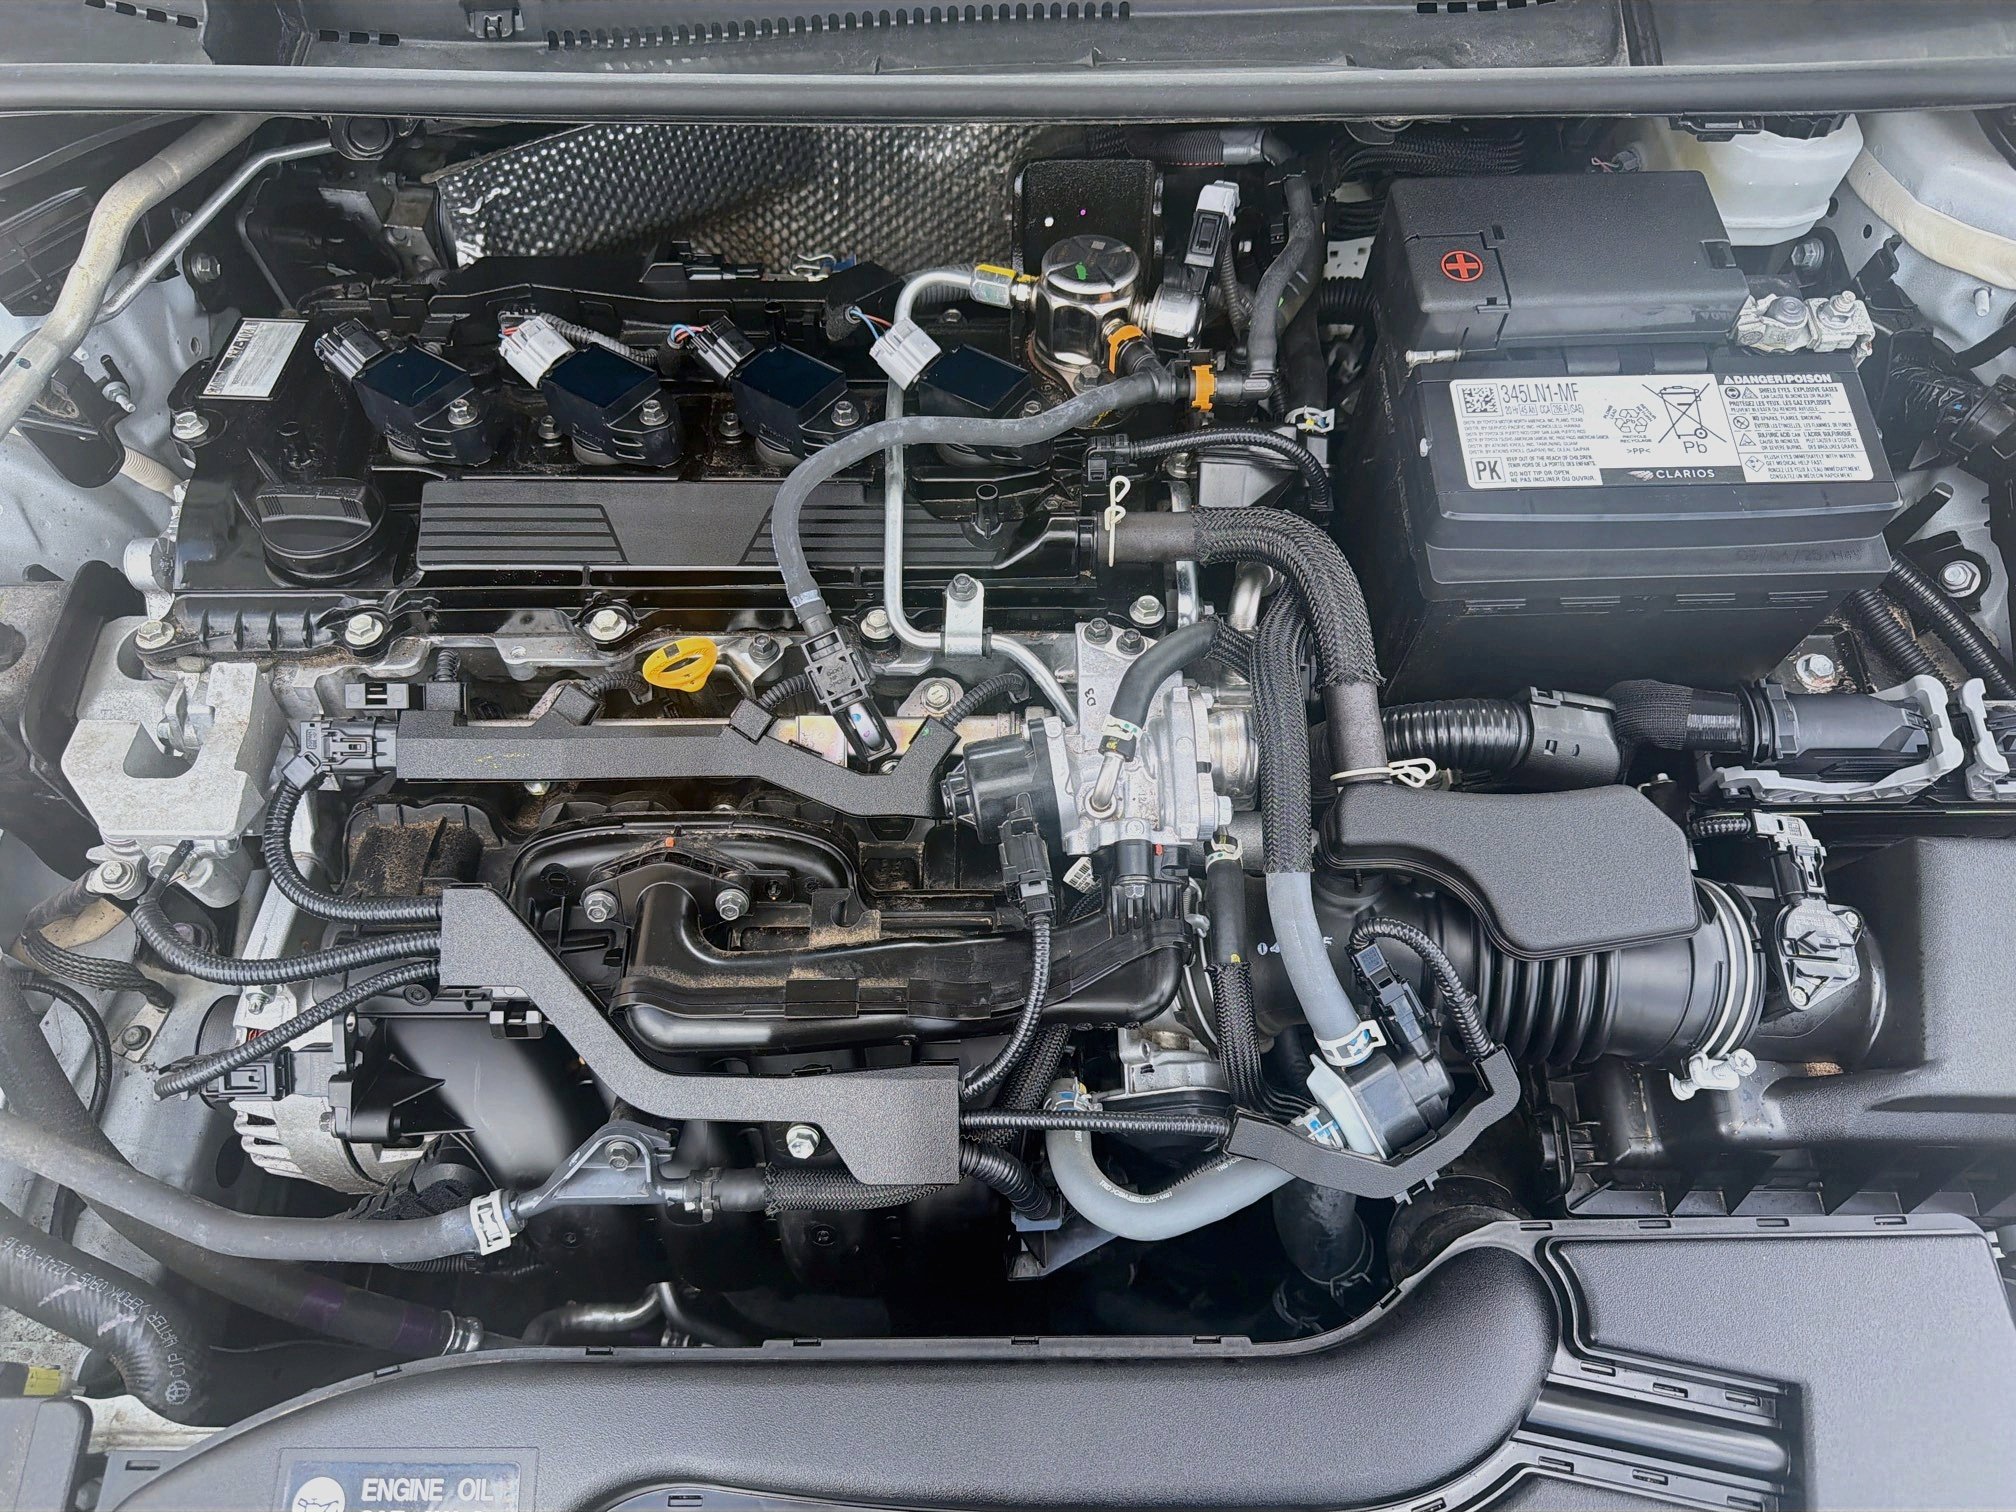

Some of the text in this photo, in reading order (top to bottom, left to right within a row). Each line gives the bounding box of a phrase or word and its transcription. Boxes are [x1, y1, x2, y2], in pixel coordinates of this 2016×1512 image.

[1733, 373, 1833, 385] DANGER/POISON
[1501, 382, 1579, 403] 345LN1-MF
[1626, 447, 1651, 455] >PP<
[1683, 440, 1708, 454] Pb
[1475, 460, 1502, 481] PK
[1656, 469, 1715, 479] CLARIOS
[147, 1311, 179, 1349] WATER
[360, 1477, 494, 1502] ENGINE OIL
